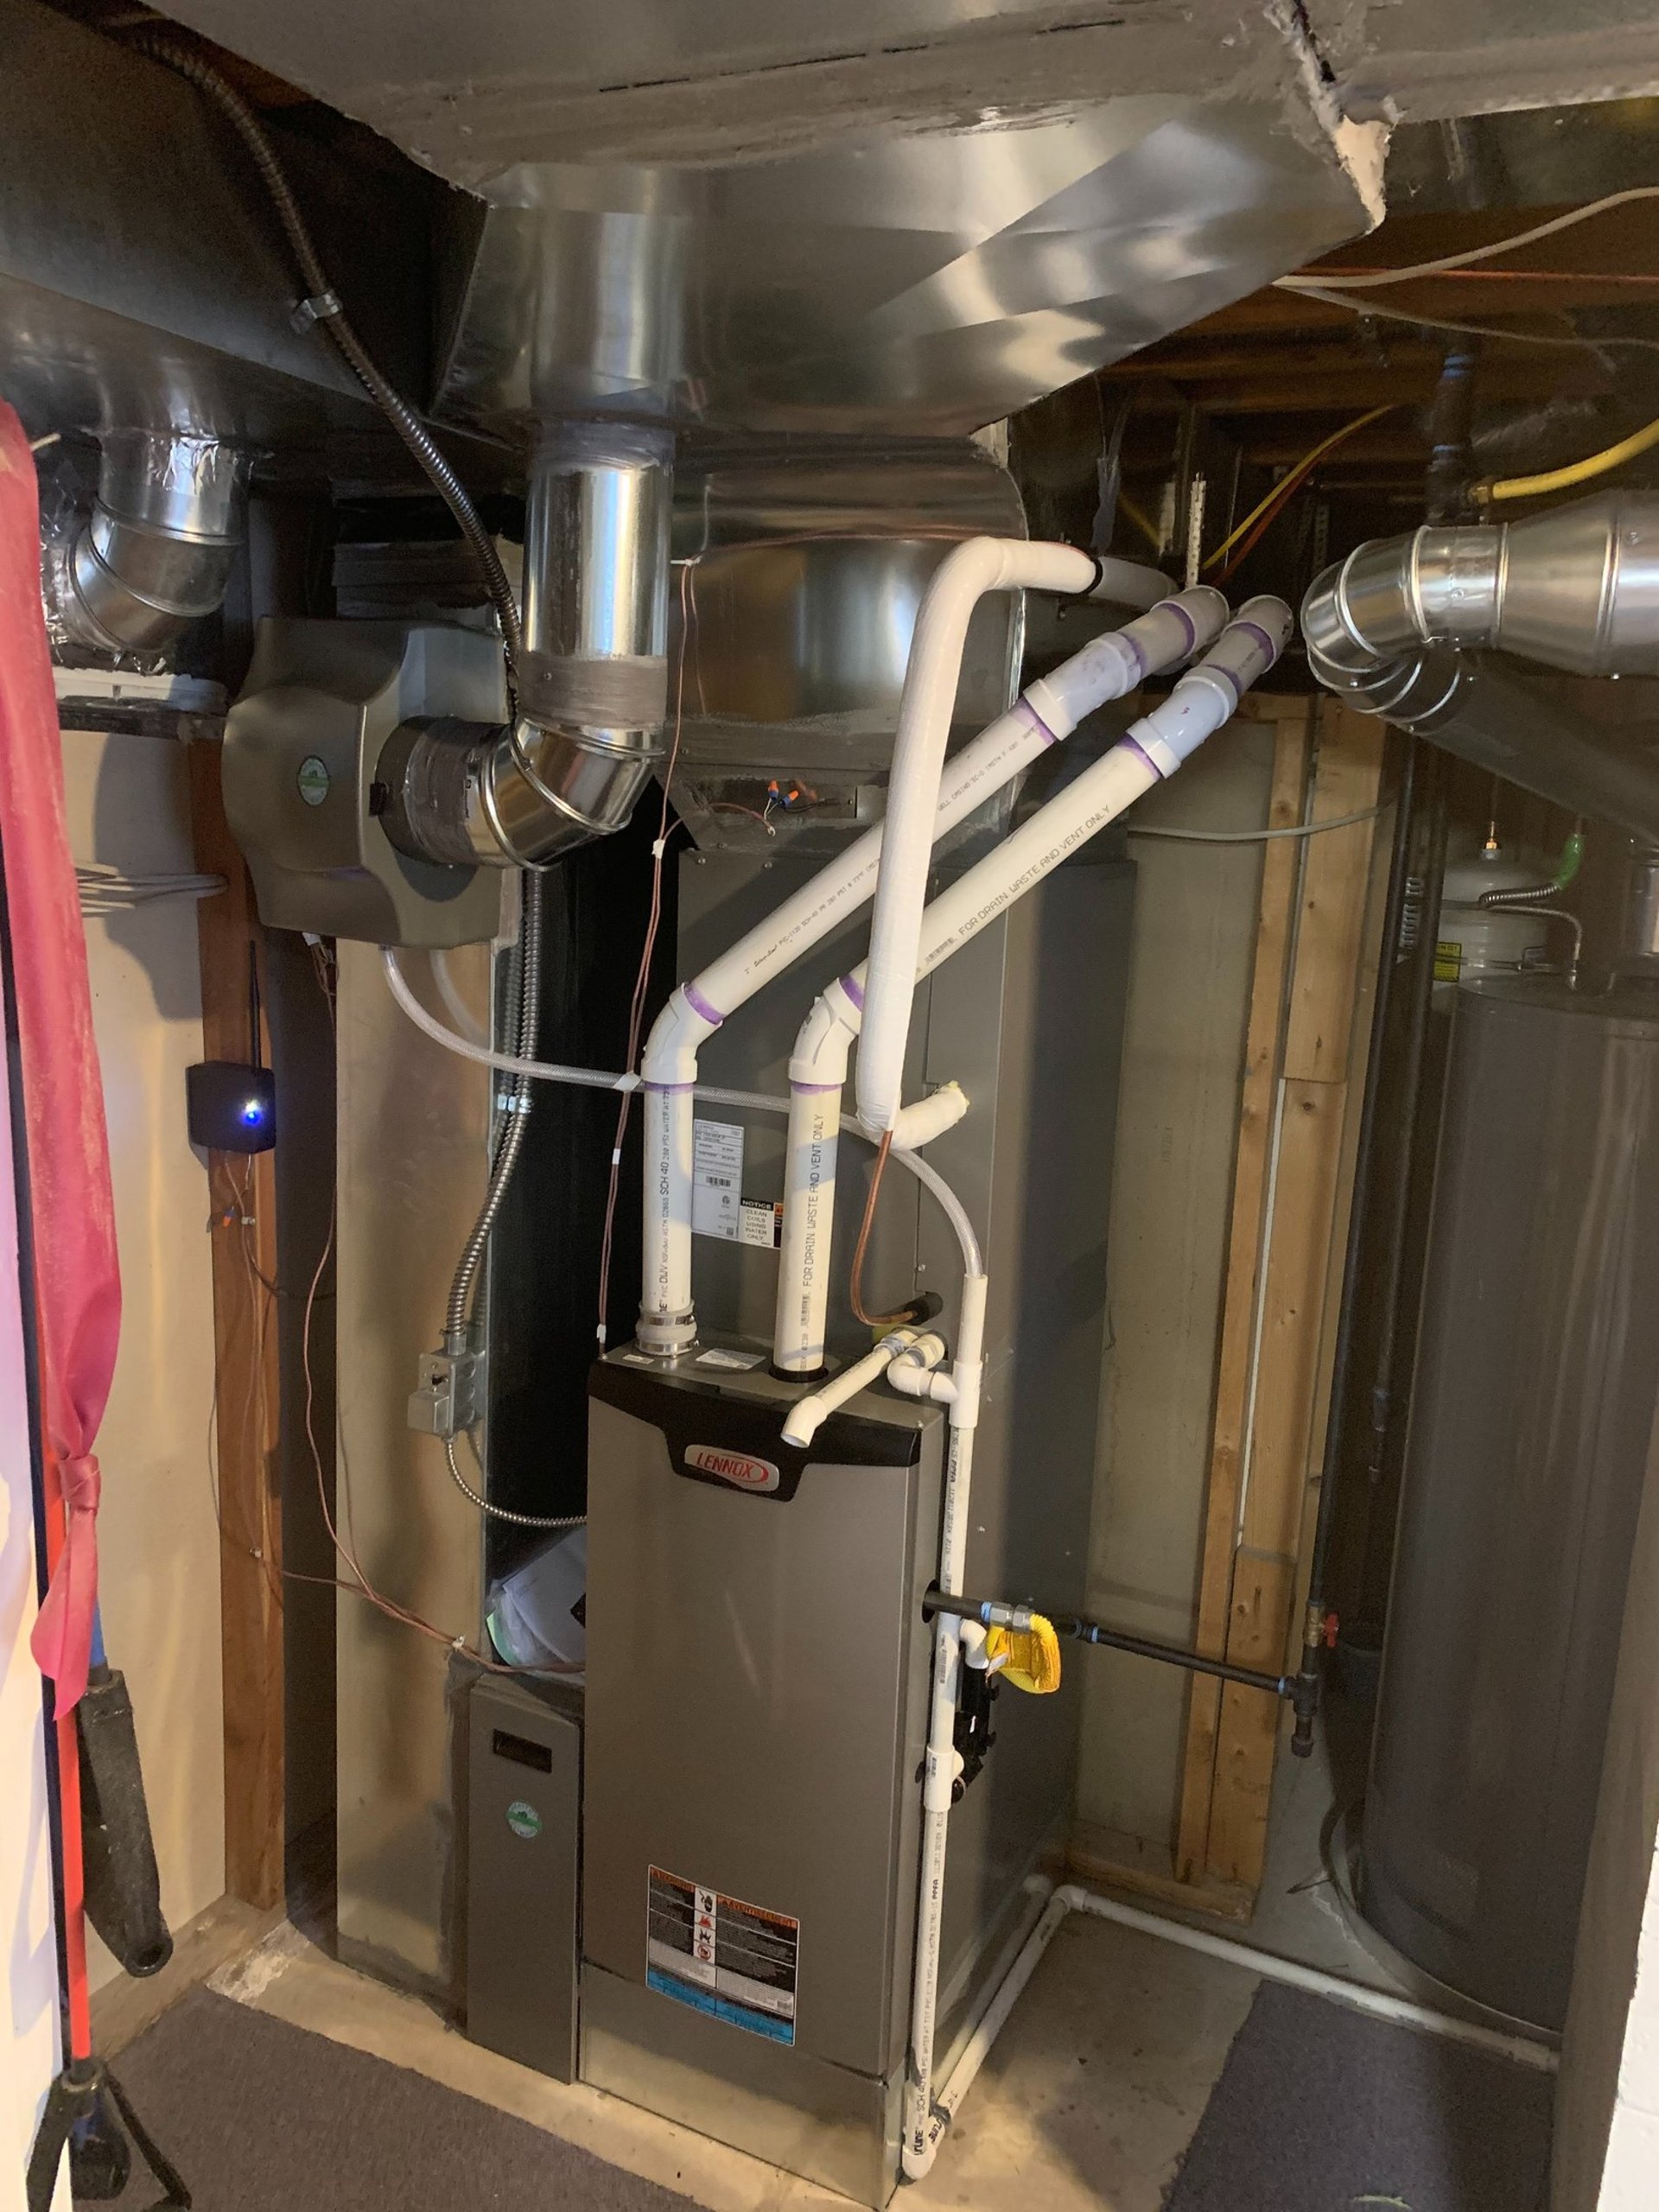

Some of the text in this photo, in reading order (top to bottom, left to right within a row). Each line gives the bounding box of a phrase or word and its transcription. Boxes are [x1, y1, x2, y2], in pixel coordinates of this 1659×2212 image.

[957, 804, 1111, 936] FOR DRAIN WASTE AND VENT ONLY
[811, 1114, 823, 1140] ONLY
[810, 1143, 822, 1169] VENT
[660, 1161, 669, 1173] 40
[659, 1175, 669, 1195] SCH
[809, 1172, 819, 1193] AND
[742, 1200, 772, 1210] NOTICE
[806, 1195, 817, 1228] WASTE
[746, 1227, 767, 1236] WATER
[804, 1232, 815, 1263] DRAIN
[659, 1264, 668, 1283] DWV
[803, 1267, 812, 1286] FOR
[696, 1452, 756, 1478] LENNOX
[916, 2094, 925, 2111] SCH
